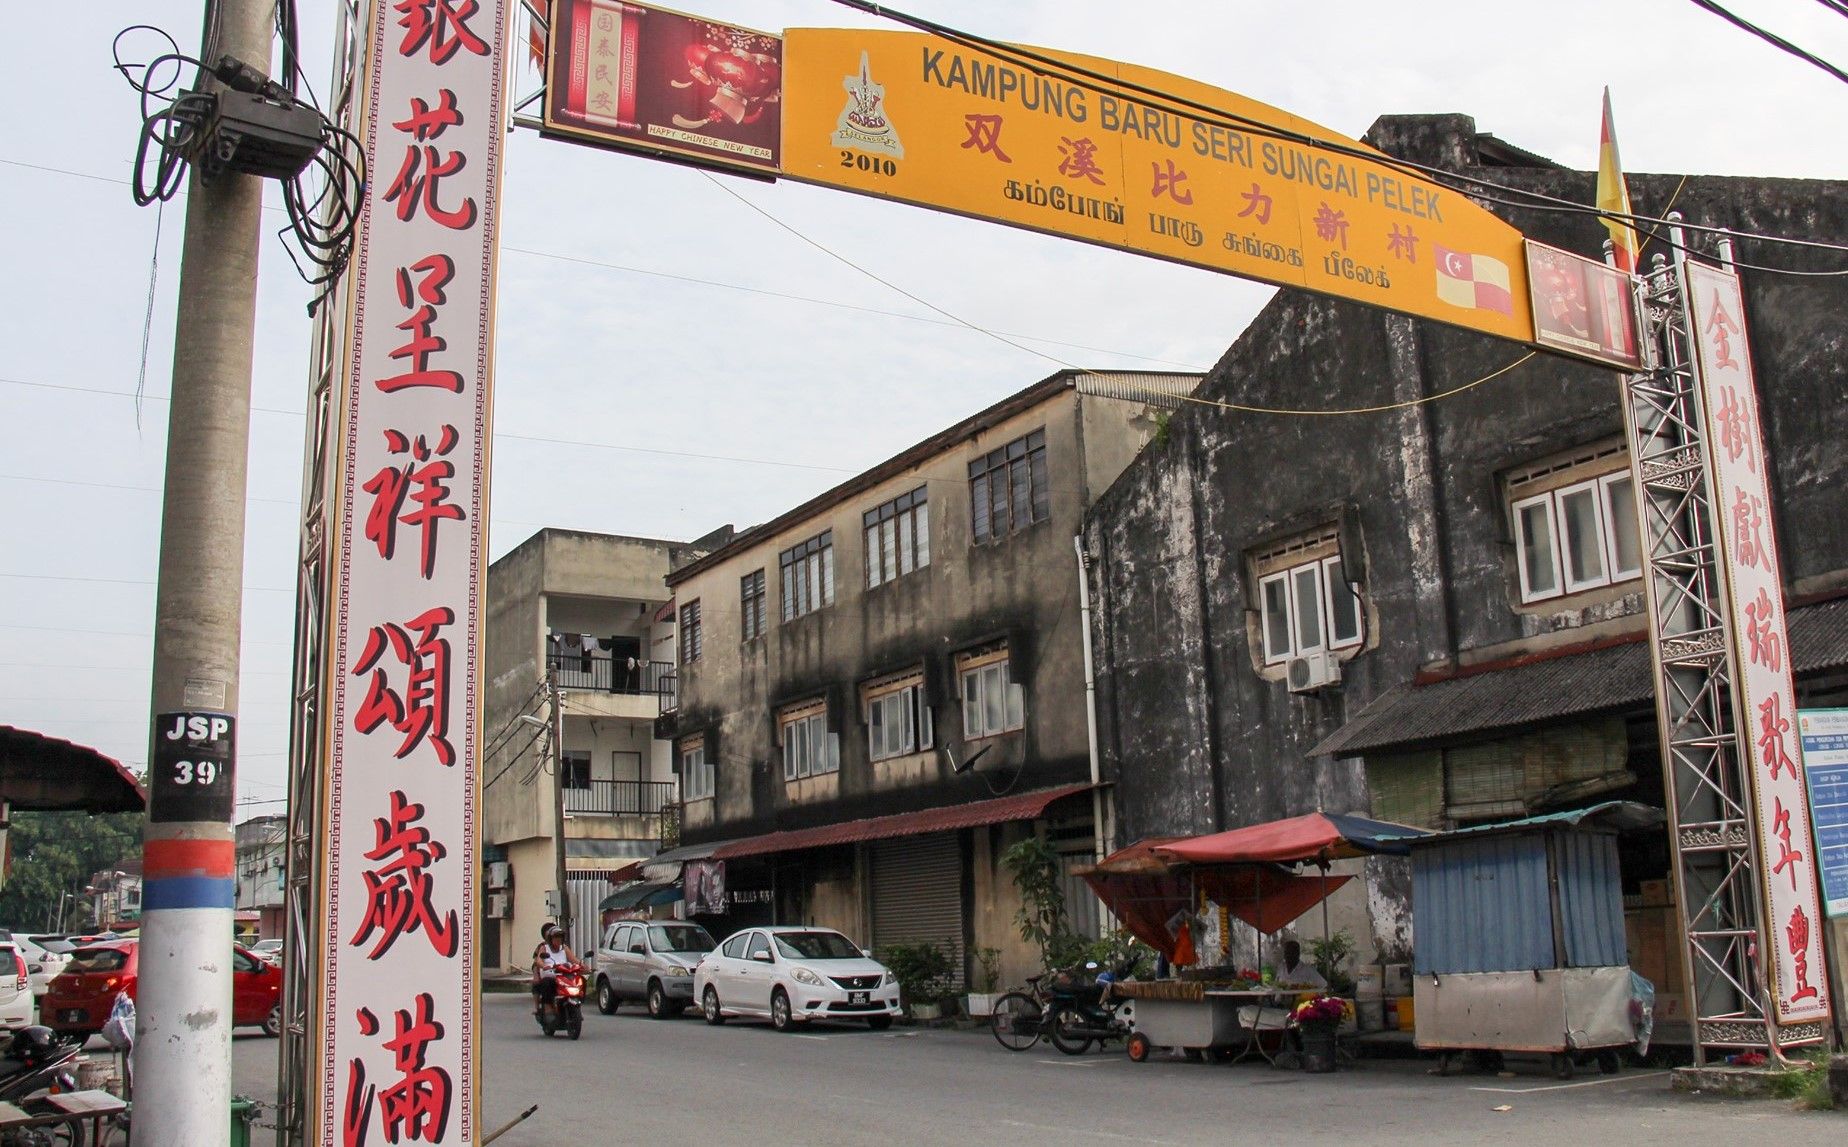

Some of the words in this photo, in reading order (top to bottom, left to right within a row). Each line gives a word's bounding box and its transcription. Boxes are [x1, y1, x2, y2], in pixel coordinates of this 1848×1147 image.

[649, 126, 676, 138] HAPPY
[681, 132, 719, 147] CHINESE
[723, 142, 744, 152] NEW
[749, 148, 770, 158] YEAR
[923, 47, 1087, 123] KAMPUNG
[1100, 95, 1180, 148] BARU
[1192, 121, 1252, 168] SERI
[1262, 142, 1358, 198] SUNGAI
[1366, 172, 1443, 223] PELEK
[841, 151, 896, 176] 2010
[167, 716, 228, 741] JSP
[174, 760, 215, 785] 39
